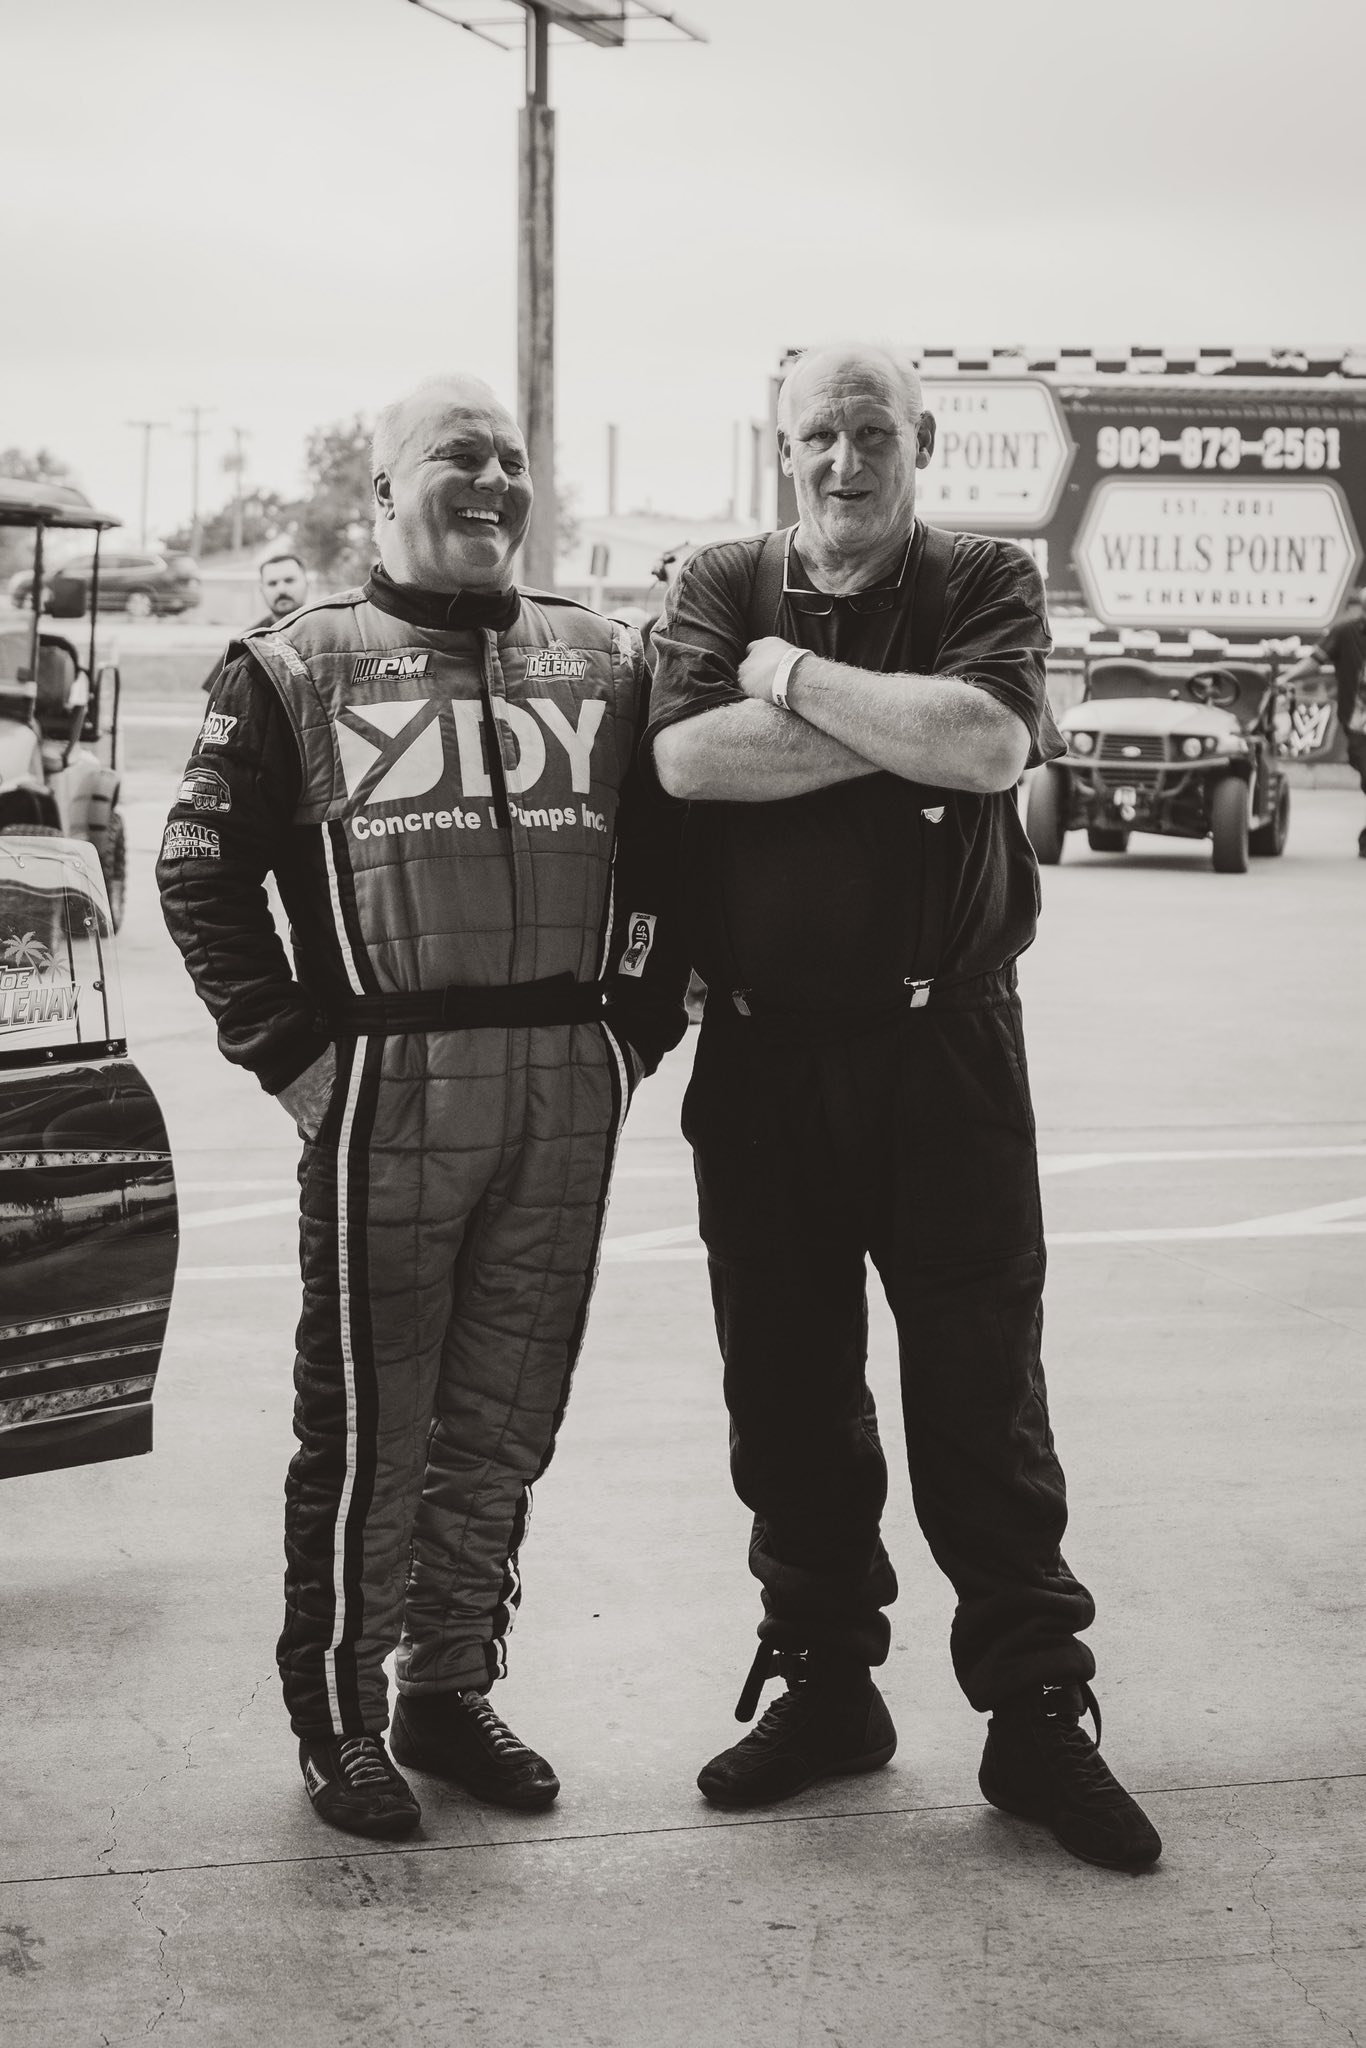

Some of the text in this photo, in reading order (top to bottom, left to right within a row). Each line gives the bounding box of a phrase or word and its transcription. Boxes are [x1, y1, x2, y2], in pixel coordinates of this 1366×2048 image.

[941, 431, 1048, 469] POINT
[1097, 426, 1341, 469] 903-873-2561
[915, 485, 980, 501] ORD
[1222, 499, 1274, 516] 2001
[1101, 533, 1336, 575] WILLS POINT
[1145, 588, 1286, 605] CHEVROLET
[354, 672, 424, 683] MOTORSPORTS
[528, 660, 585, 677] DELEHAY
[351, 806, 481, 840] Concrete
[581, 803, 607, 833] Inc.
[164, 822, 219, 845] NAMIC
[0, 971, 31, 991] OE
[0, 986, 81, 1027] LEHAY
